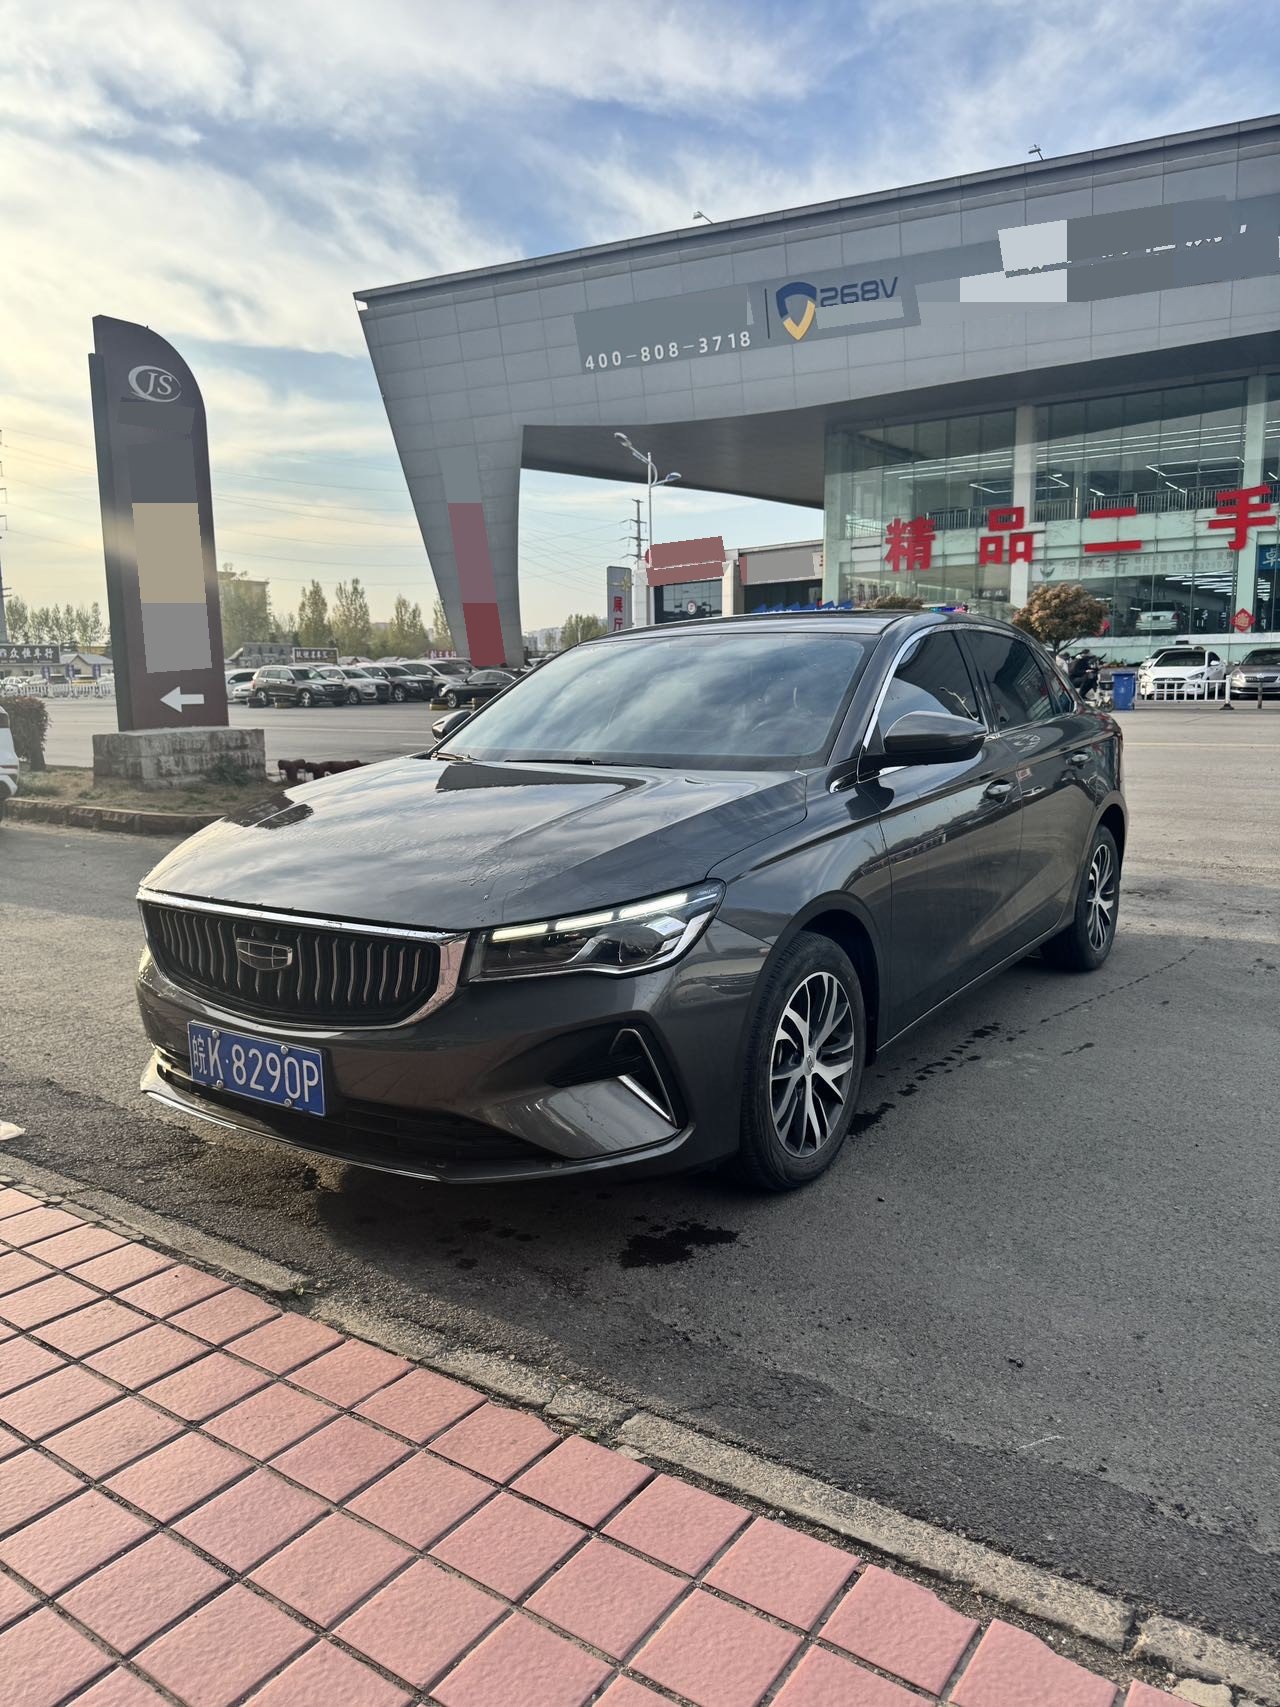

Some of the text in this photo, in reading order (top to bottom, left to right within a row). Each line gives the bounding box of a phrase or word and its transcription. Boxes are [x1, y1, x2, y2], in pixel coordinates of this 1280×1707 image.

[820, 276, 899, 307] 268V
[585, 331, 751, 370] 400-808-3718
[884, 484, 1277, 573] 精品二手
